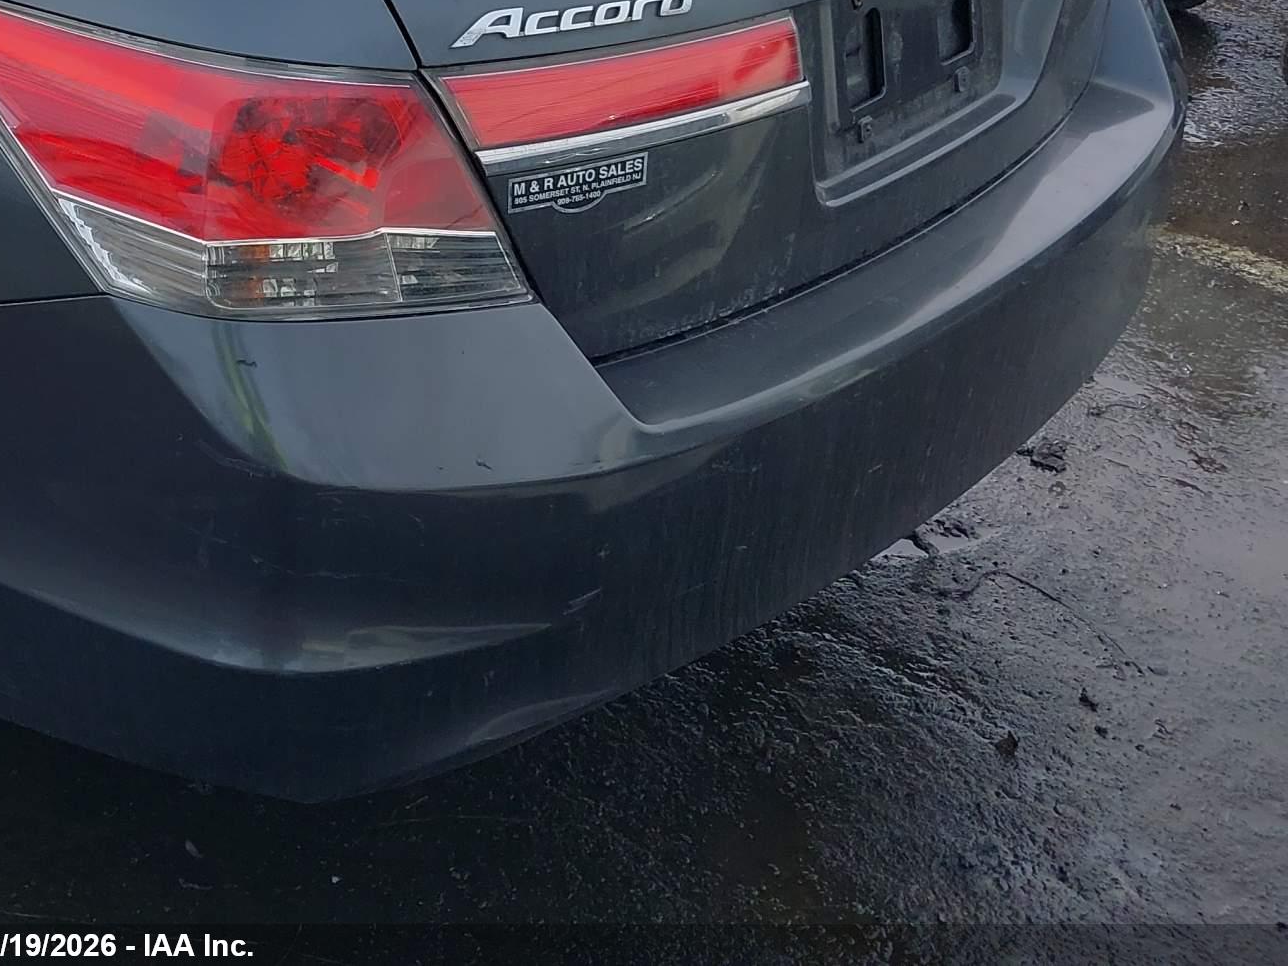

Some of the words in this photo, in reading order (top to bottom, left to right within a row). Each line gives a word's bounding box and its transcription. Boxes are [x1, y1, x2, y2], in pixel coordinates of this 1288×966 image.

[513, 183, 525, 196] M
[529, 180, 540, 193] &
[544, 177, 554, 191] R
[557, 169, 596, 188] AUTO
[599, 158, 643, 179] SALES
[528, 188, 569, 202] SOMERSET
[632, 172, 642, 181] NJ
